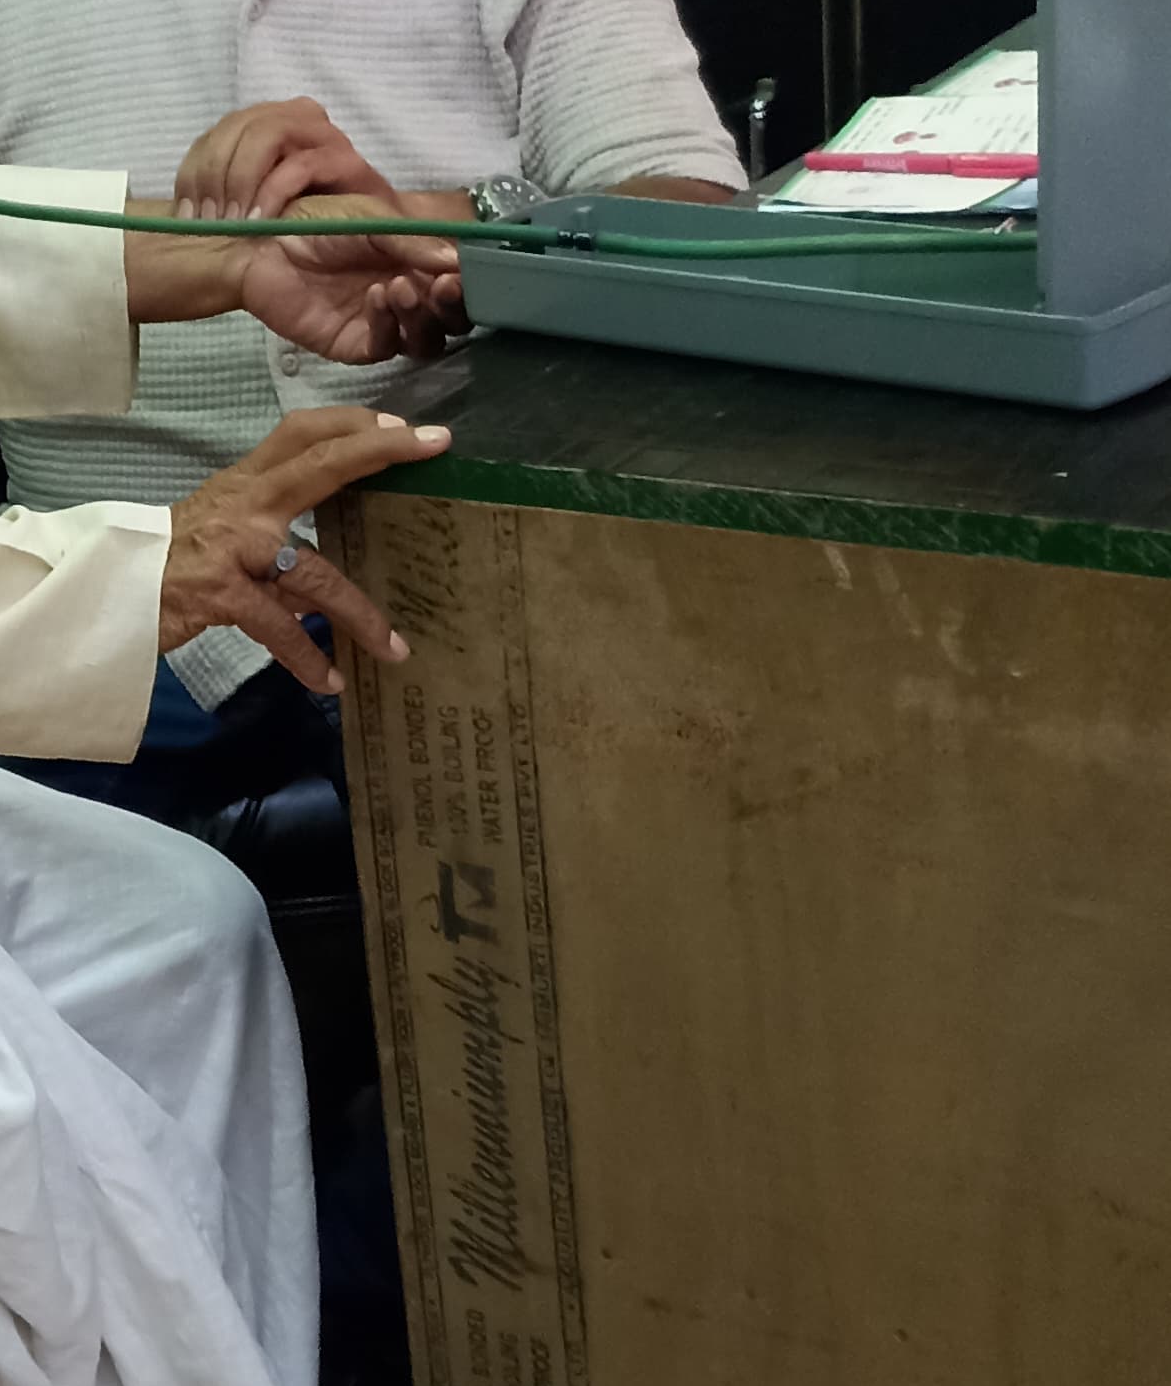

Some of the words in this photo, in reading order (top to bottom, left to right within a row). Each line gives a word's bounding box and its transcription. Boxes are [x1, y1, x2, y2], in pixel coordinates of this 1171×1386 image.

[403, 684, 429, 766] BONDED
[437, 704, 464, 783] BOILING
[471, 704, 495, 772] PROOF
[412, 773, 437, 849] PHENOL
[477, 778, 504, 845] WATER
[518, 804, 544, 936] INDUSTRIES
[426, 956, 525, 1292] Millenniumply
